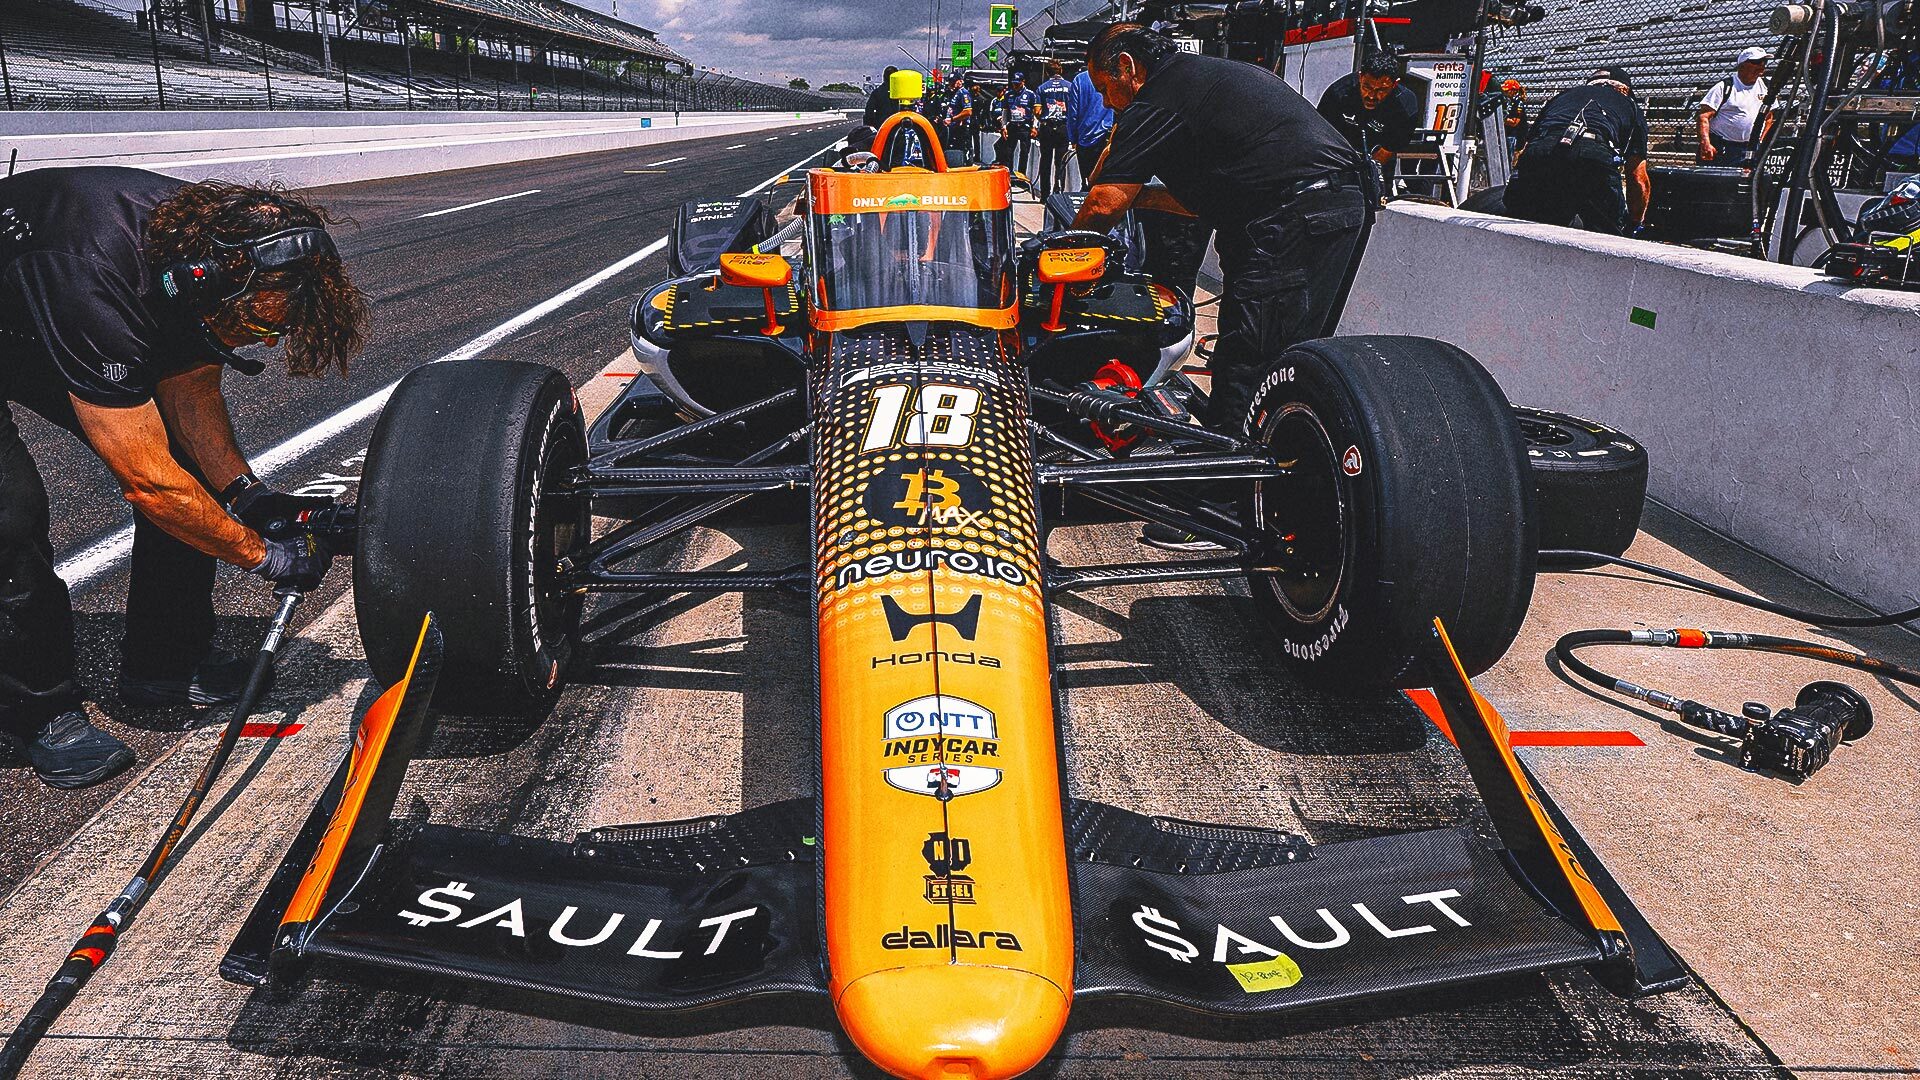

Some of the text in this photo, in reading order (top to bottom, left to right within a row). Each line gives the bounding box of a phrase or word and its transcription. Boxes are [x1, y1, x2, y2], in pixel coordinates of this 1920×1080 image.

[995, 11, 1008, 30] 4
[1433, 61, 1465, 72] renta
[1432, 103, 1463, 134] 18
[852, 195, 968, 208] ONLY BULLS
[1243, 366, 1296, 437] Firestone
[858, 383, 983, 455] 18
[917, 505, 988, 530] MAX
[1284, 604, 1349, 662] Firestone
[871, 651, 1001, 669] Honda
[929, 712, 984, 730] NTT
[883, 737, 999, 758] INDYCAR
[907, 754, 974, 765] SERIES
[932, 884, 971, 898] STEEL
[881, 924, 1023, 952] dallara
